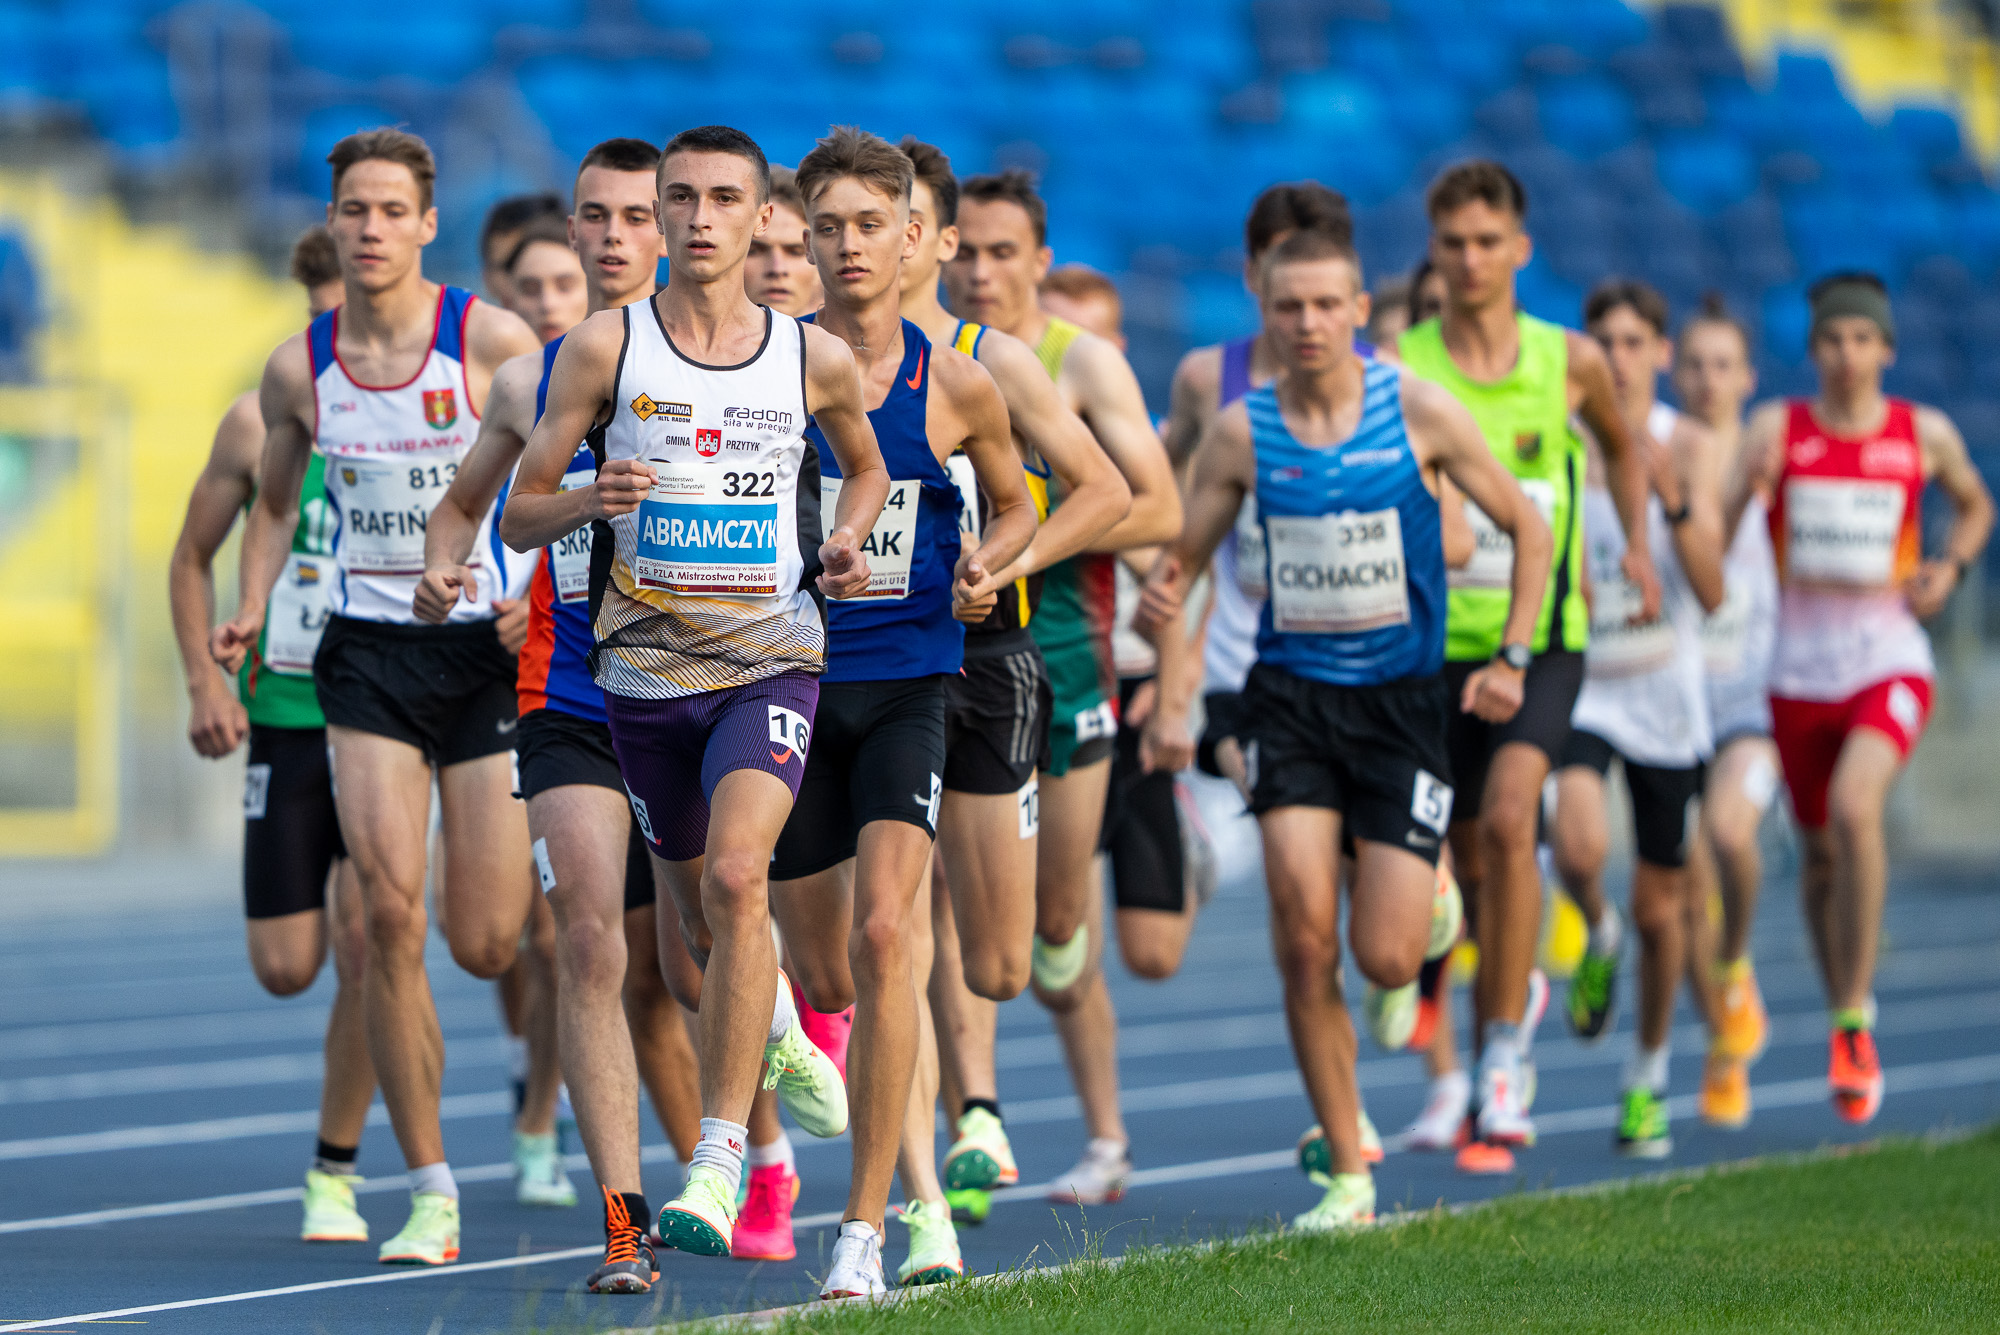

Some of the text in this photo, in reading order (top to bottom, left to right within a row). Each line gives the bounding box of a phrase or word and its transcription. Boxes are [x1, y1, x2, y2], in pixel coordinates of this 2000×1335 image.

[658, 403, 691, 415] OPTIMA
[723, 418, 741, 427] siła
[758, 421, 792, 435] precyzji
[376, 434, 464, 452] LUBAWA
[665, 435, 760, 451] GMINA PRZYTYK
[722, 472, 775, 497] 322
[883, 488, 905, 510] 4
[559, 527, 591, 556] SKR
[643, 515, 777, 548] ABRAMCZYK
[639, 565, 651, 575] 55.
[654, 569, 674, 579] PZLA
[677, 572, 734, 581] Mistrzostwa
[739, 572, 766, 581] Polski
[889, 576, 906, 585] U18
[1278, 560, 1399, 590] CICHACKI
[771, 712, 809, 756] 16
